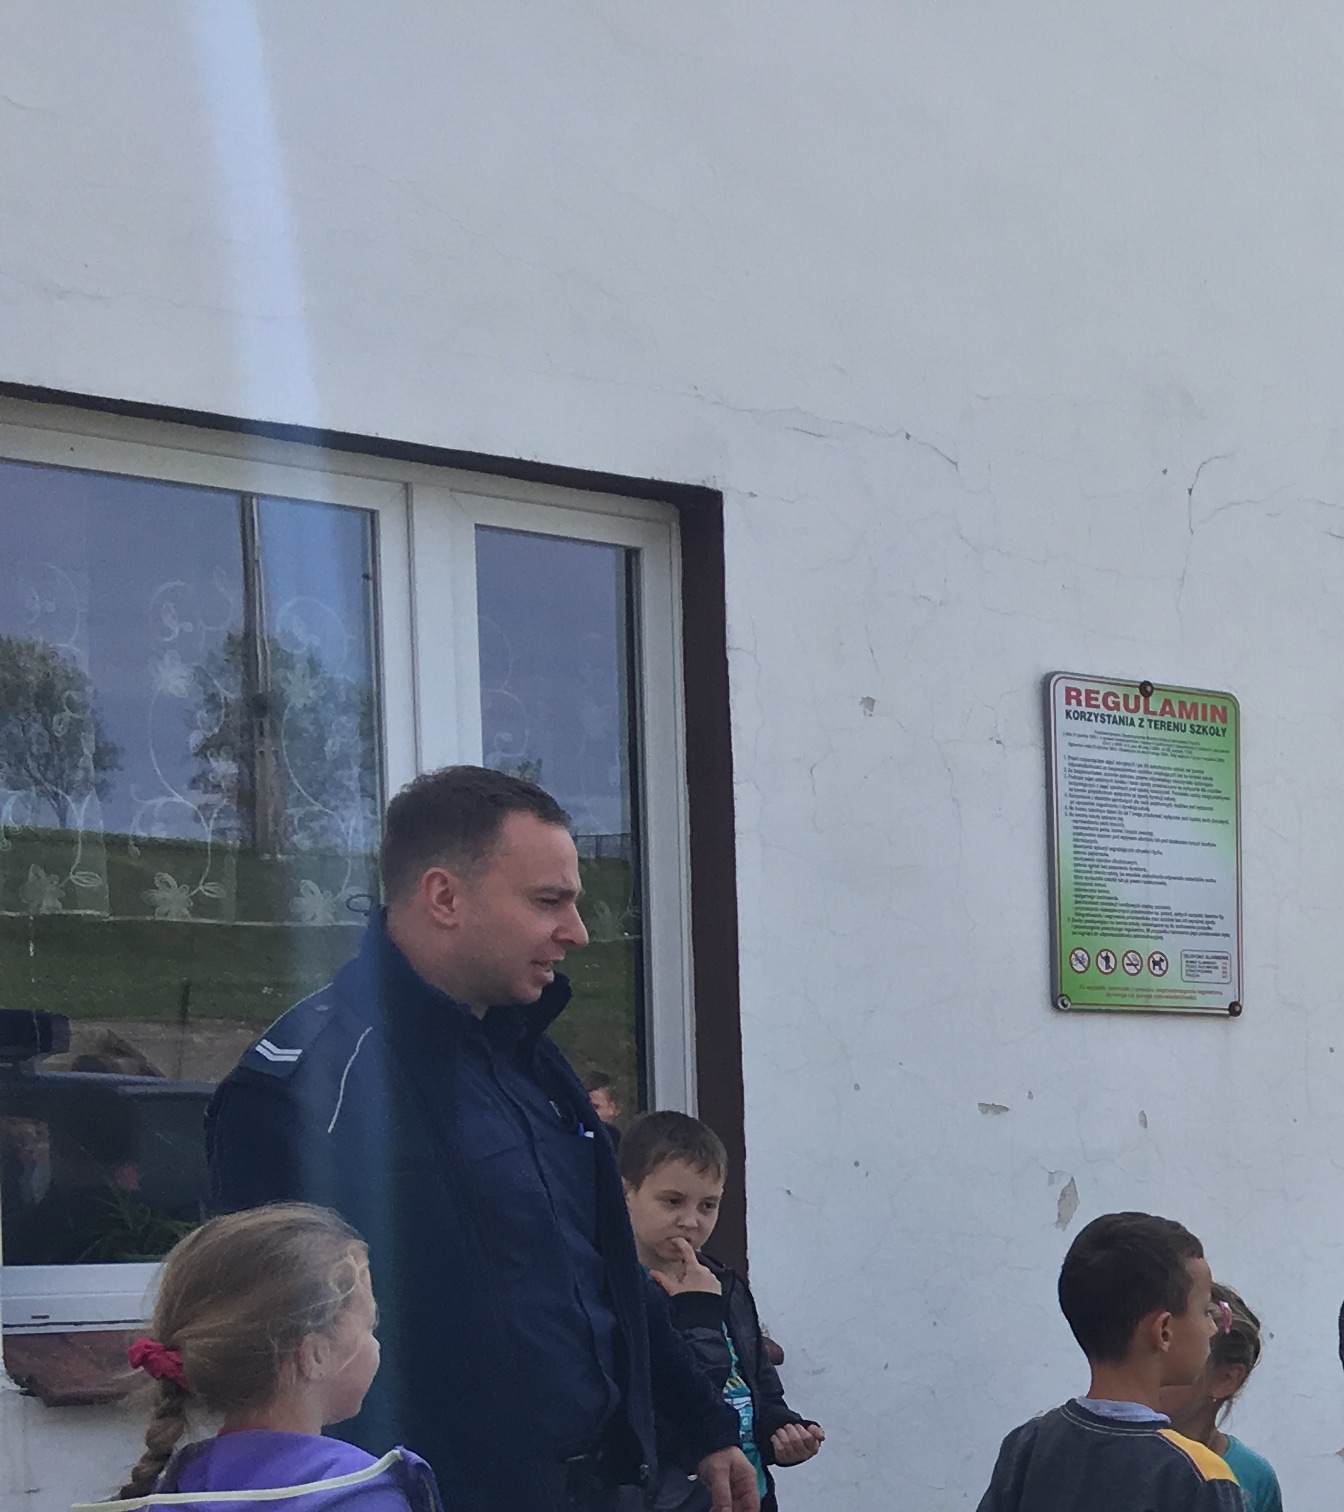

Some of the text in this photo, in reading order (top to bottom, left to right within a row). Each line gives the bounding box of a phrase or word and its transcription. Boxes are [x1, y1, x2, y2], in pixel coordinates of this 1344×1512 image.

[1064, 685, 1228, 725] REGULAMIN
[1065, 708, 1228, 738] KORZYSTANIA Z TERENU SZKOŁY
